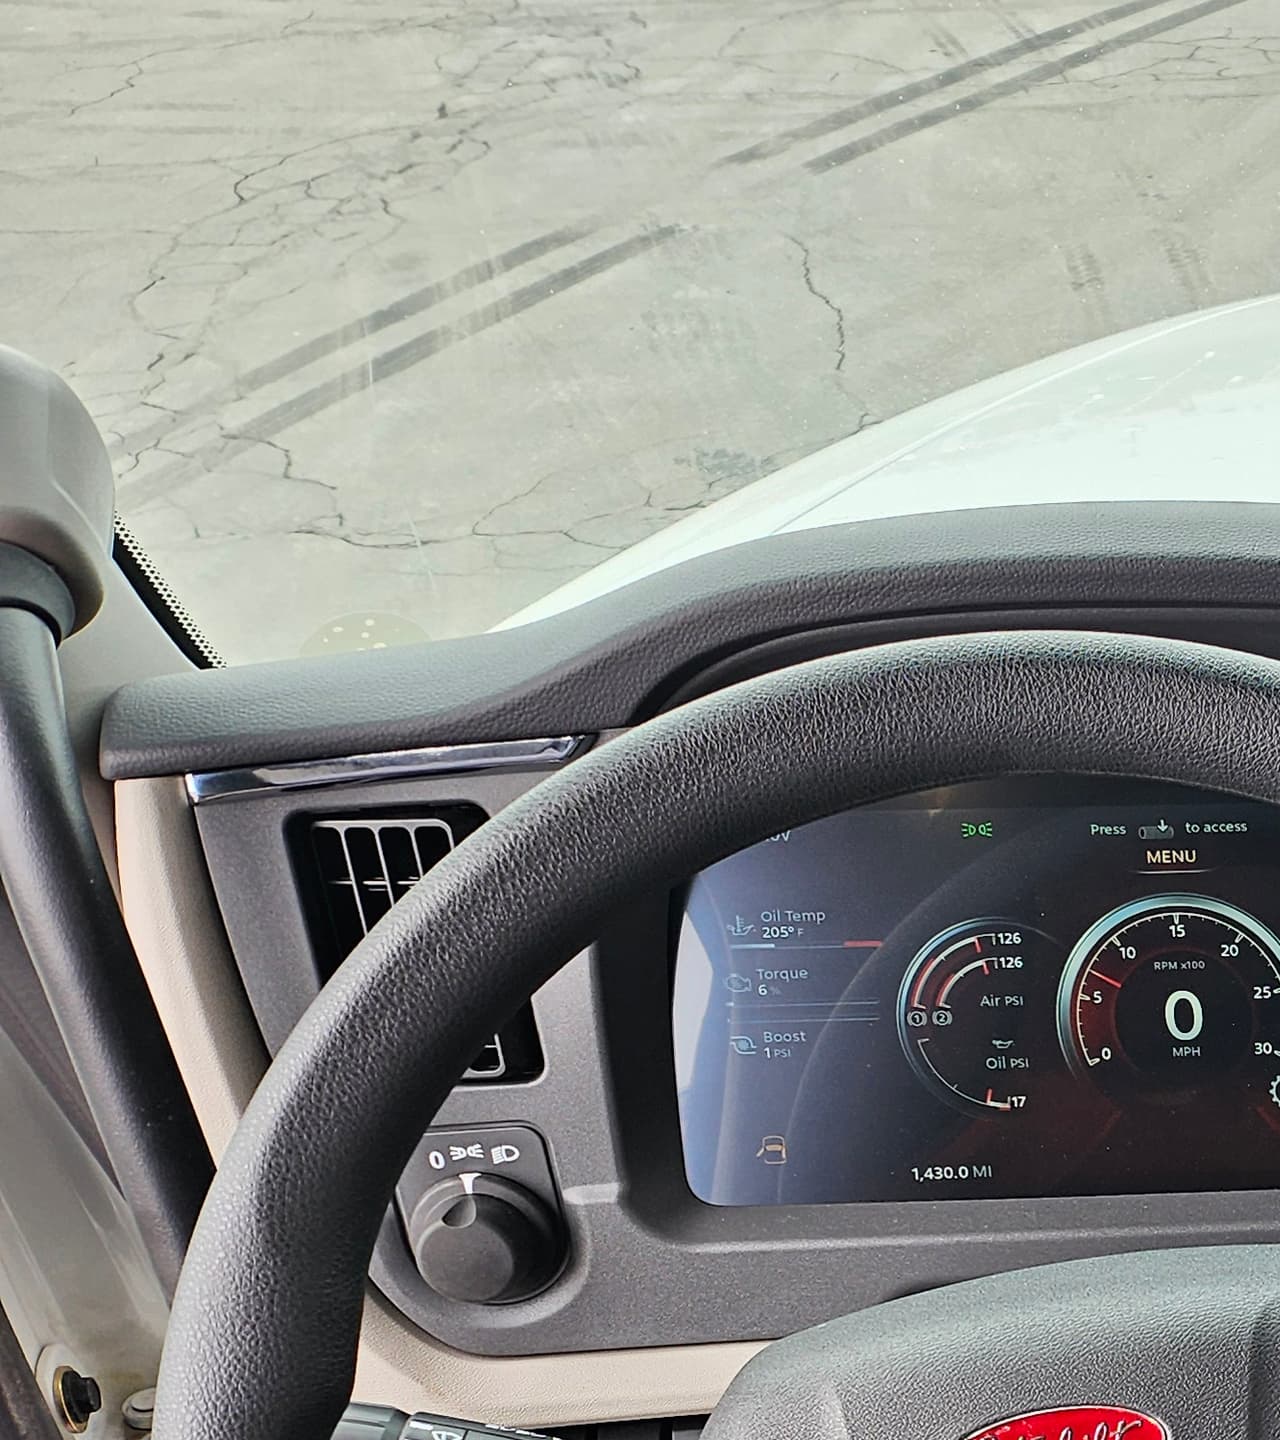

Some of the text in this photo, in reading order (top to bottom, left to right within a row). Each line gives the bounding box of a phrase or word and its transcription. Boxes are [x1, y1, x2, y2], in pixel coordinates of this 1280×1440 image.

[1090, 822, 1248, 835] Press to access
[1146, 850, 1197, 864] MENU
[761, 909, 826, 925] Oil Temp
[1169, 925, 1186, 938] 15
[998, 932, 1022, 945] 126
[1119, 947, 1137, 960] 10
[1221, 943, 1240, 957] 20
[999, 957, 1023, 969] 126
[1153, 960, 1206, 971] RPM x100
[756, 968, 808, 982] Torque
[758, 984, 768, 996] 6
[1253, 986, 1273, 1000] 25
[980, 994, 1024, 1007] Air PSI
[1092, 992, 1103, 1004] 5
[1165, 989, 1204, 1041] 0
[763, 1031, 807, 1043] Boost
[764, 1047, 791, 1059] 1 PSI
[1101, 1047, 1112, 1061] 0
[1172, 1045, 1201, 1058] MPH
[1253, 1042, 1273, 1056] 30
[985, 1056, 1029, 1069] Oil PSI
[1011, 1096, 1027, 1108] 17
[911, 1165, 993, 1181] 1,430.0 MI
